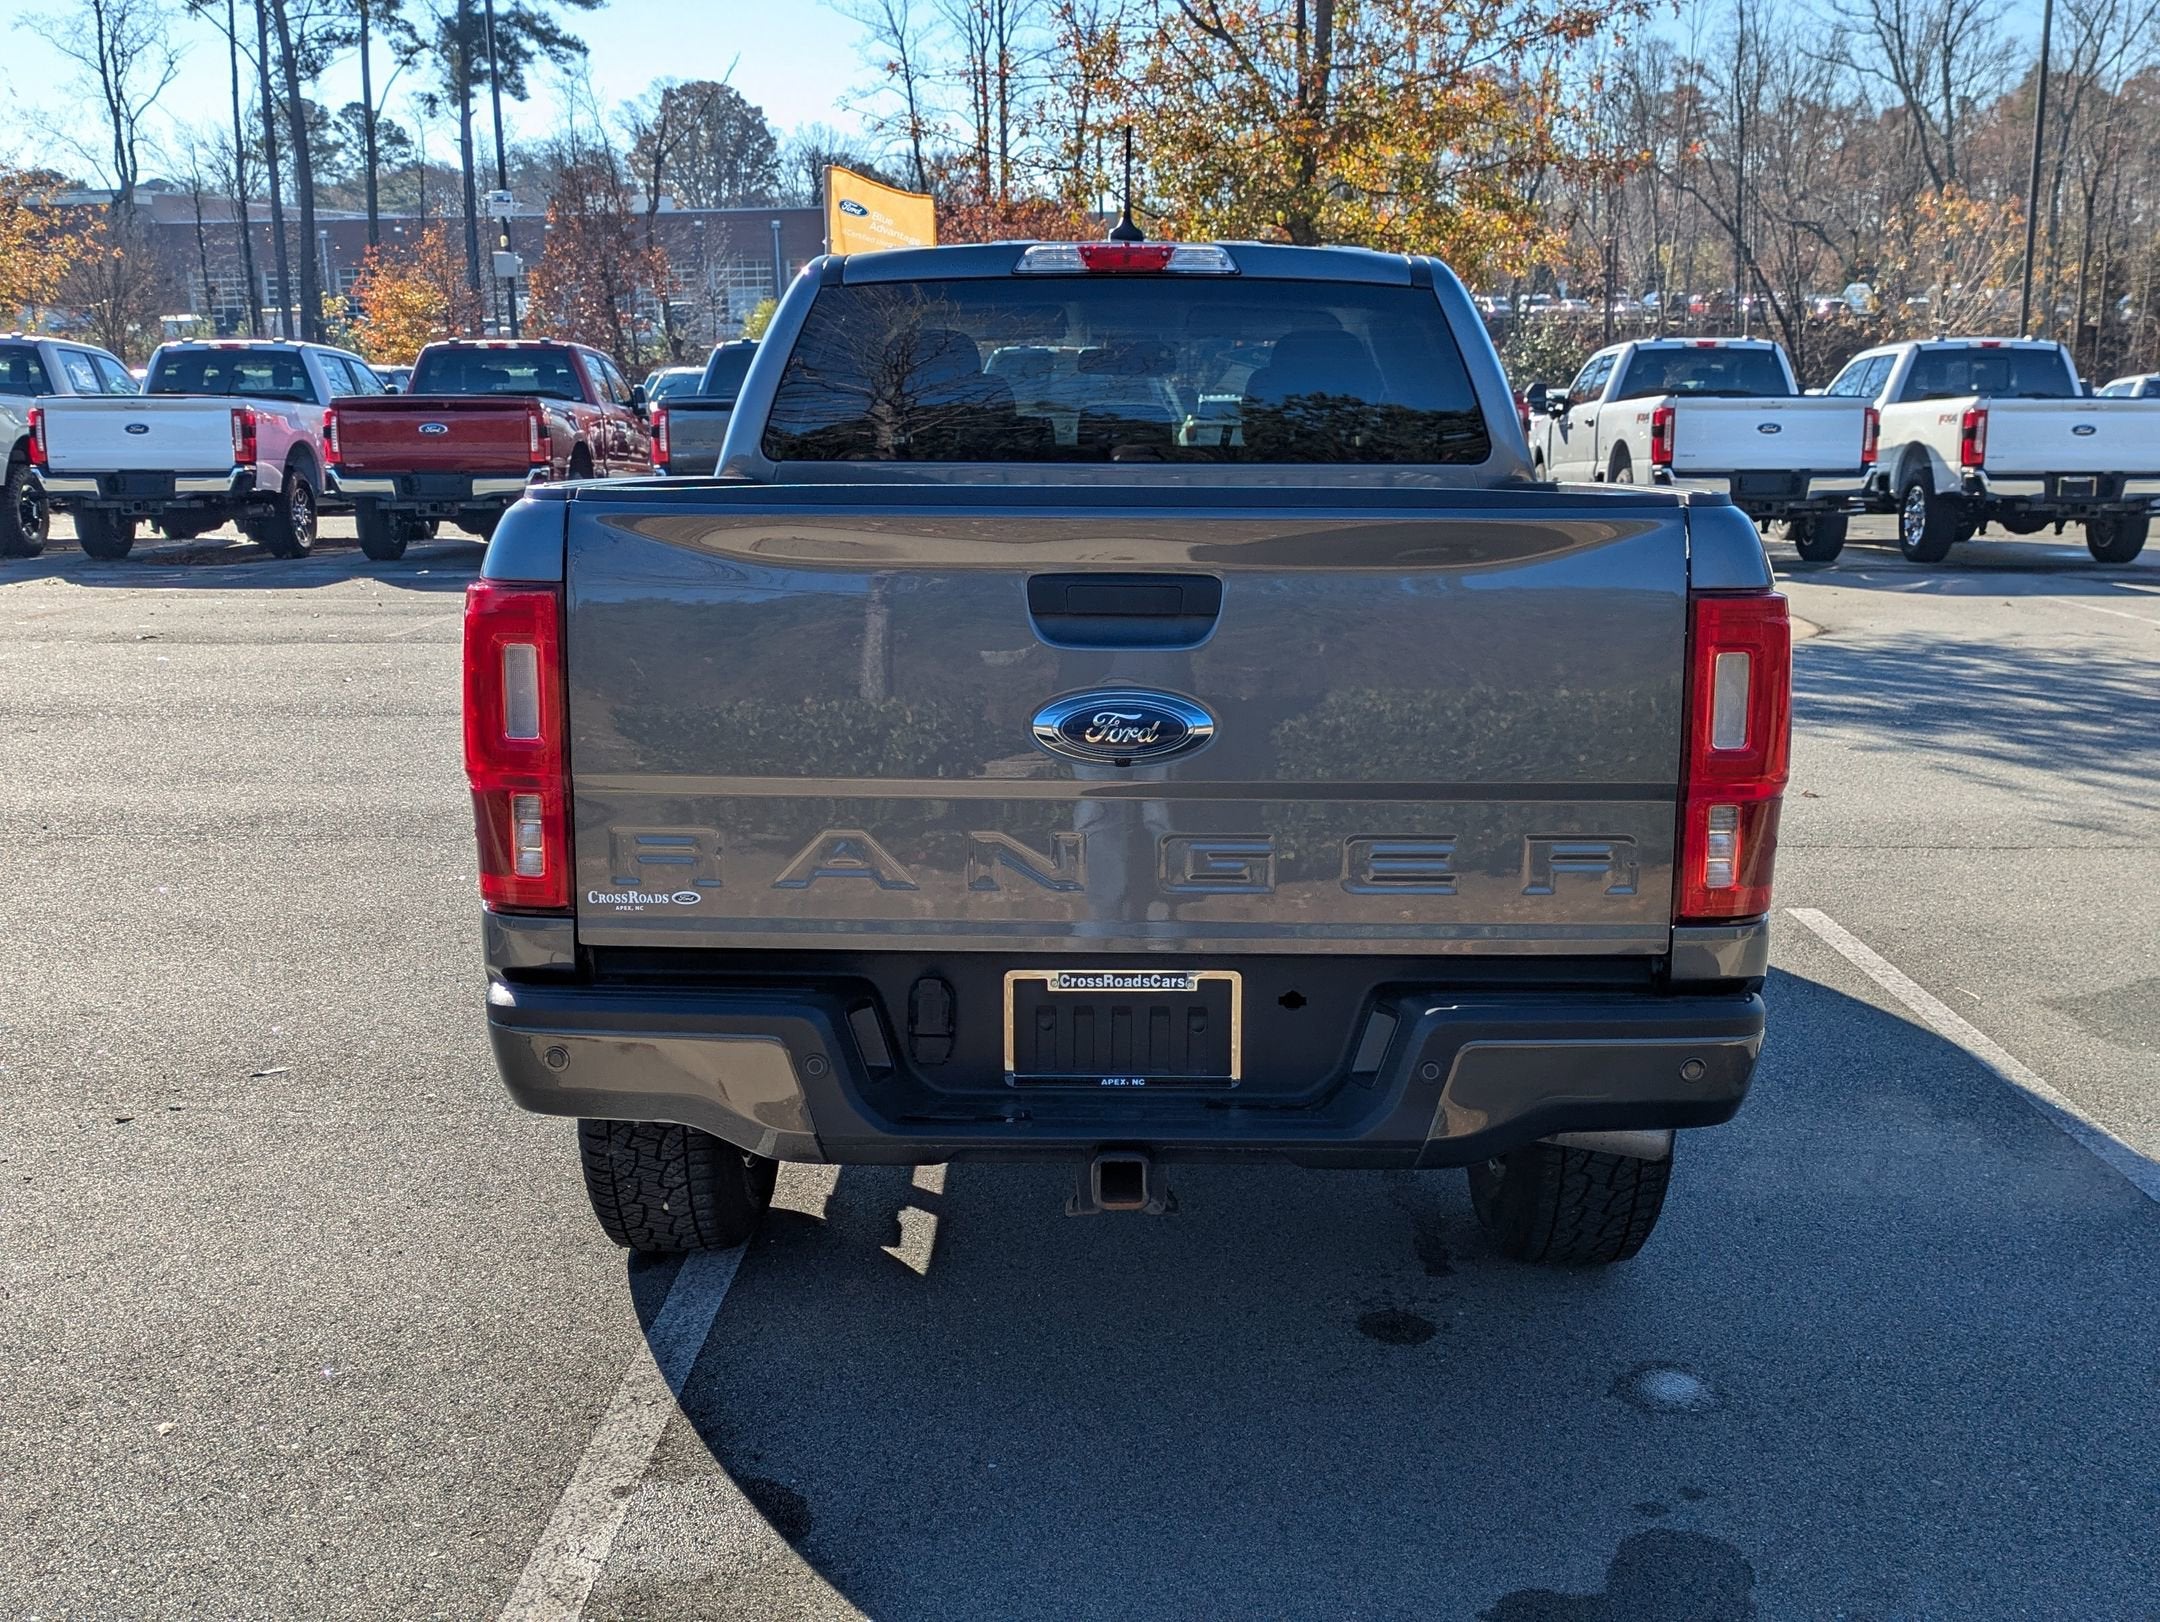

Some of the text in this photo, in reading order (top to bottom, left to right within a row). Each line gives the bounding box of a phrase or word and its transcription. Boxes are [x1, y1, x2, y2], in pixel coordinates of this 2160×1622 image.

[841, 201, 864, 216] Ford
[871, 211, 894, 226] Blue
[869, 221, 921, 247] Advantage
[1084, 711, 1161, 744] Ford
[608, 825, 1639, 896] RANGER
[1059, 973, 1186, 989] CrossRoadsCars
[1101, 1078, 1146, 1087] APEX, NC
